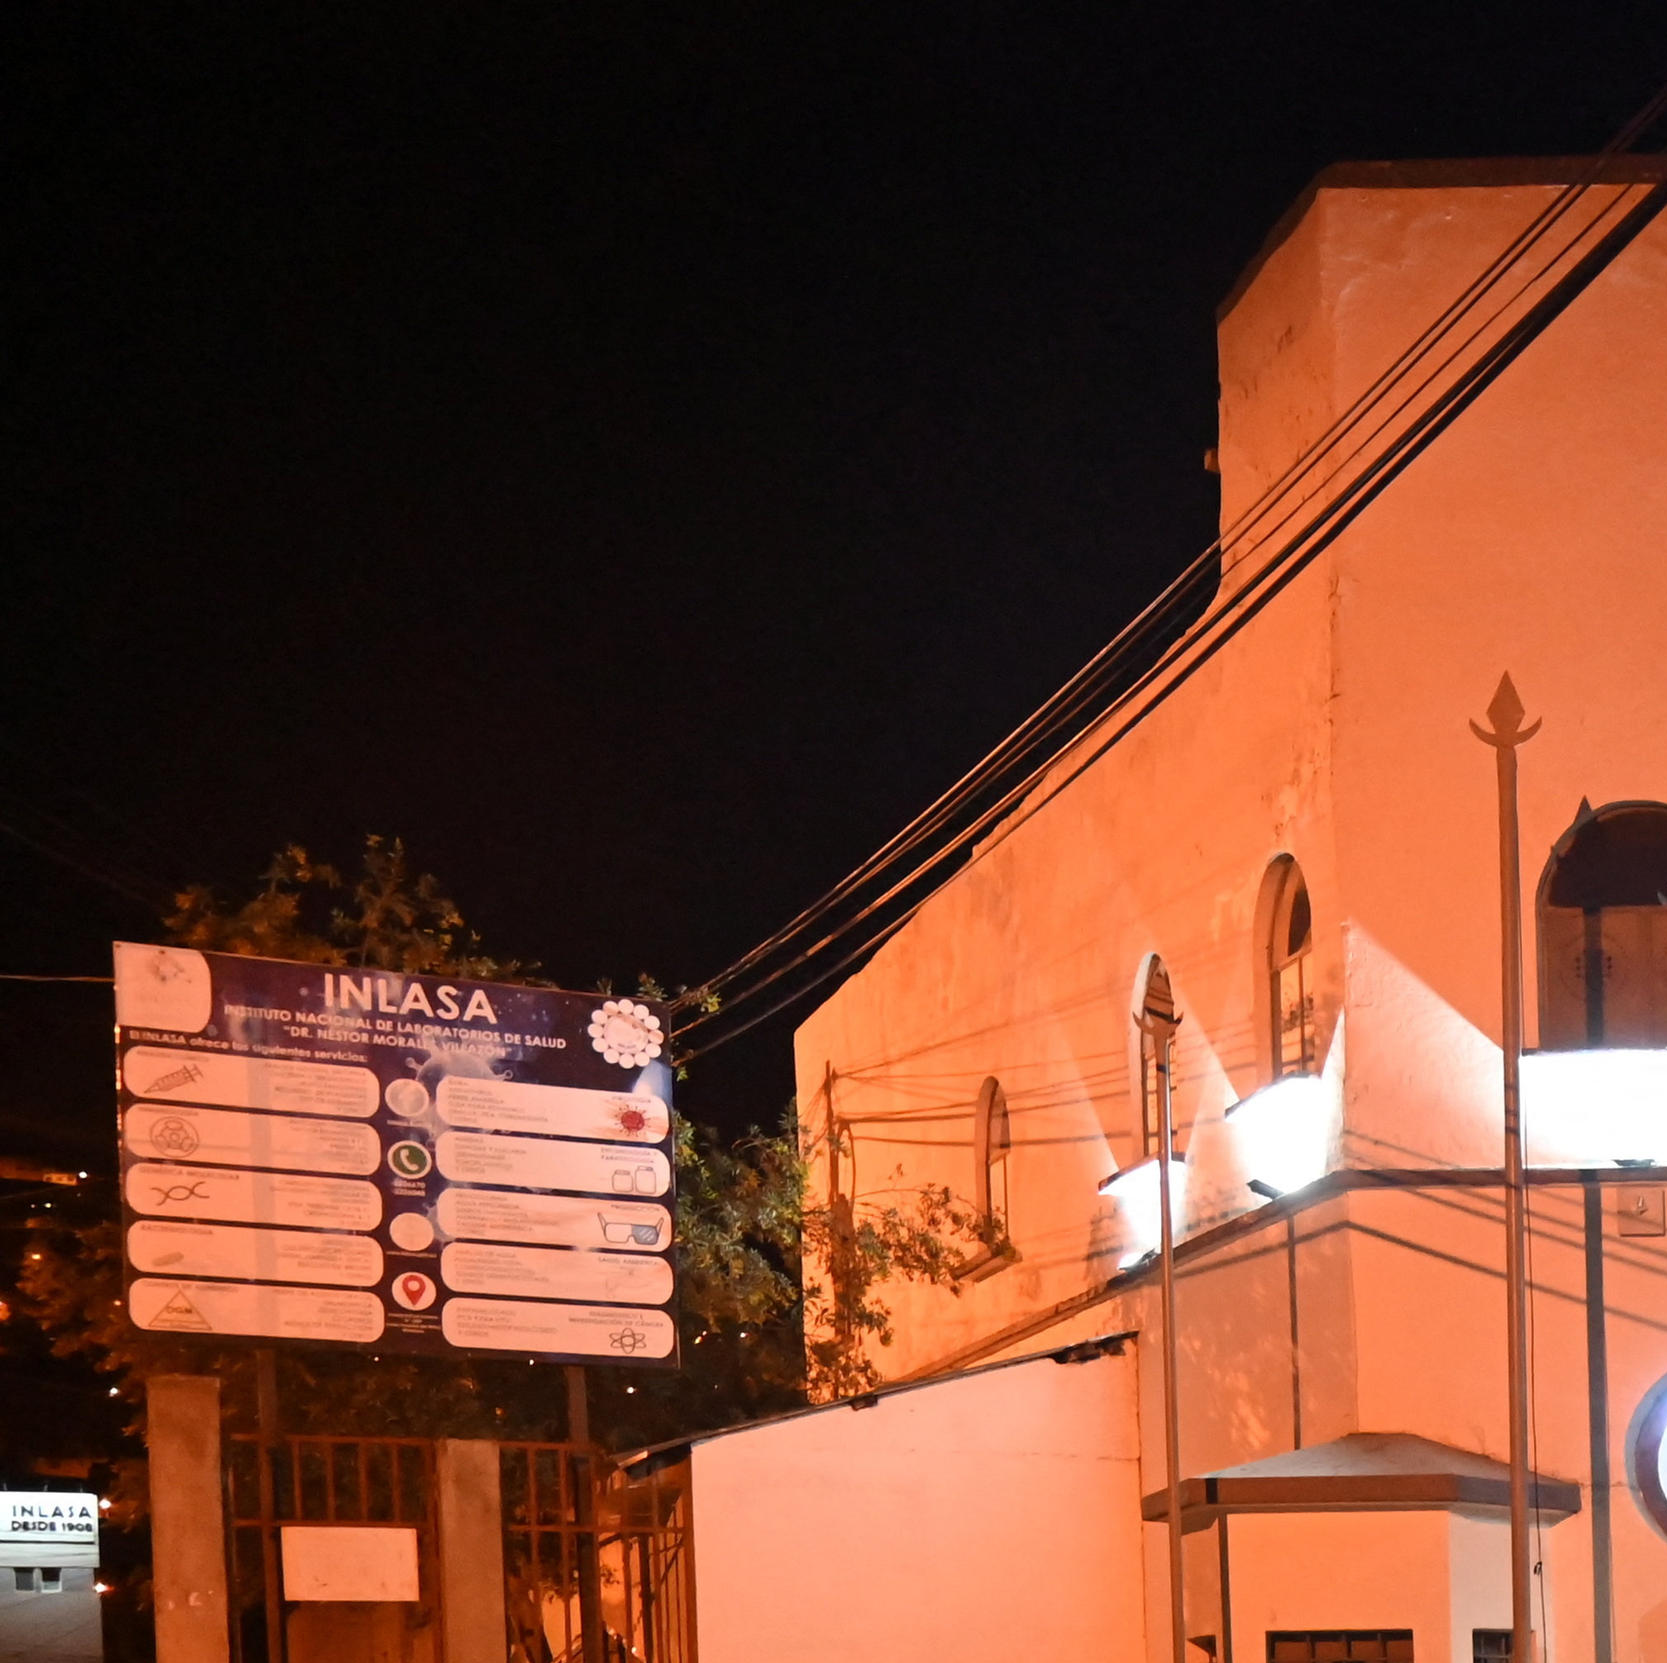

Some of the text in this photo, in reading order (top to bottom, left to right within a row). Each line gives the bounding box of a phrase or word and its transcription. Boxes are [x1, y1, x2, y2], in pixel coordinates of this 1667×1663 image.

[324, 973, 498, 1025] INLASA
[224, 1004, 567, 1049] INSTITUTO NACIONAL DE LABORATORIOS DE SALUD
[12, 1505, 91, 1518] INLASA
[11, 1521, 56, 1532] DESDE
